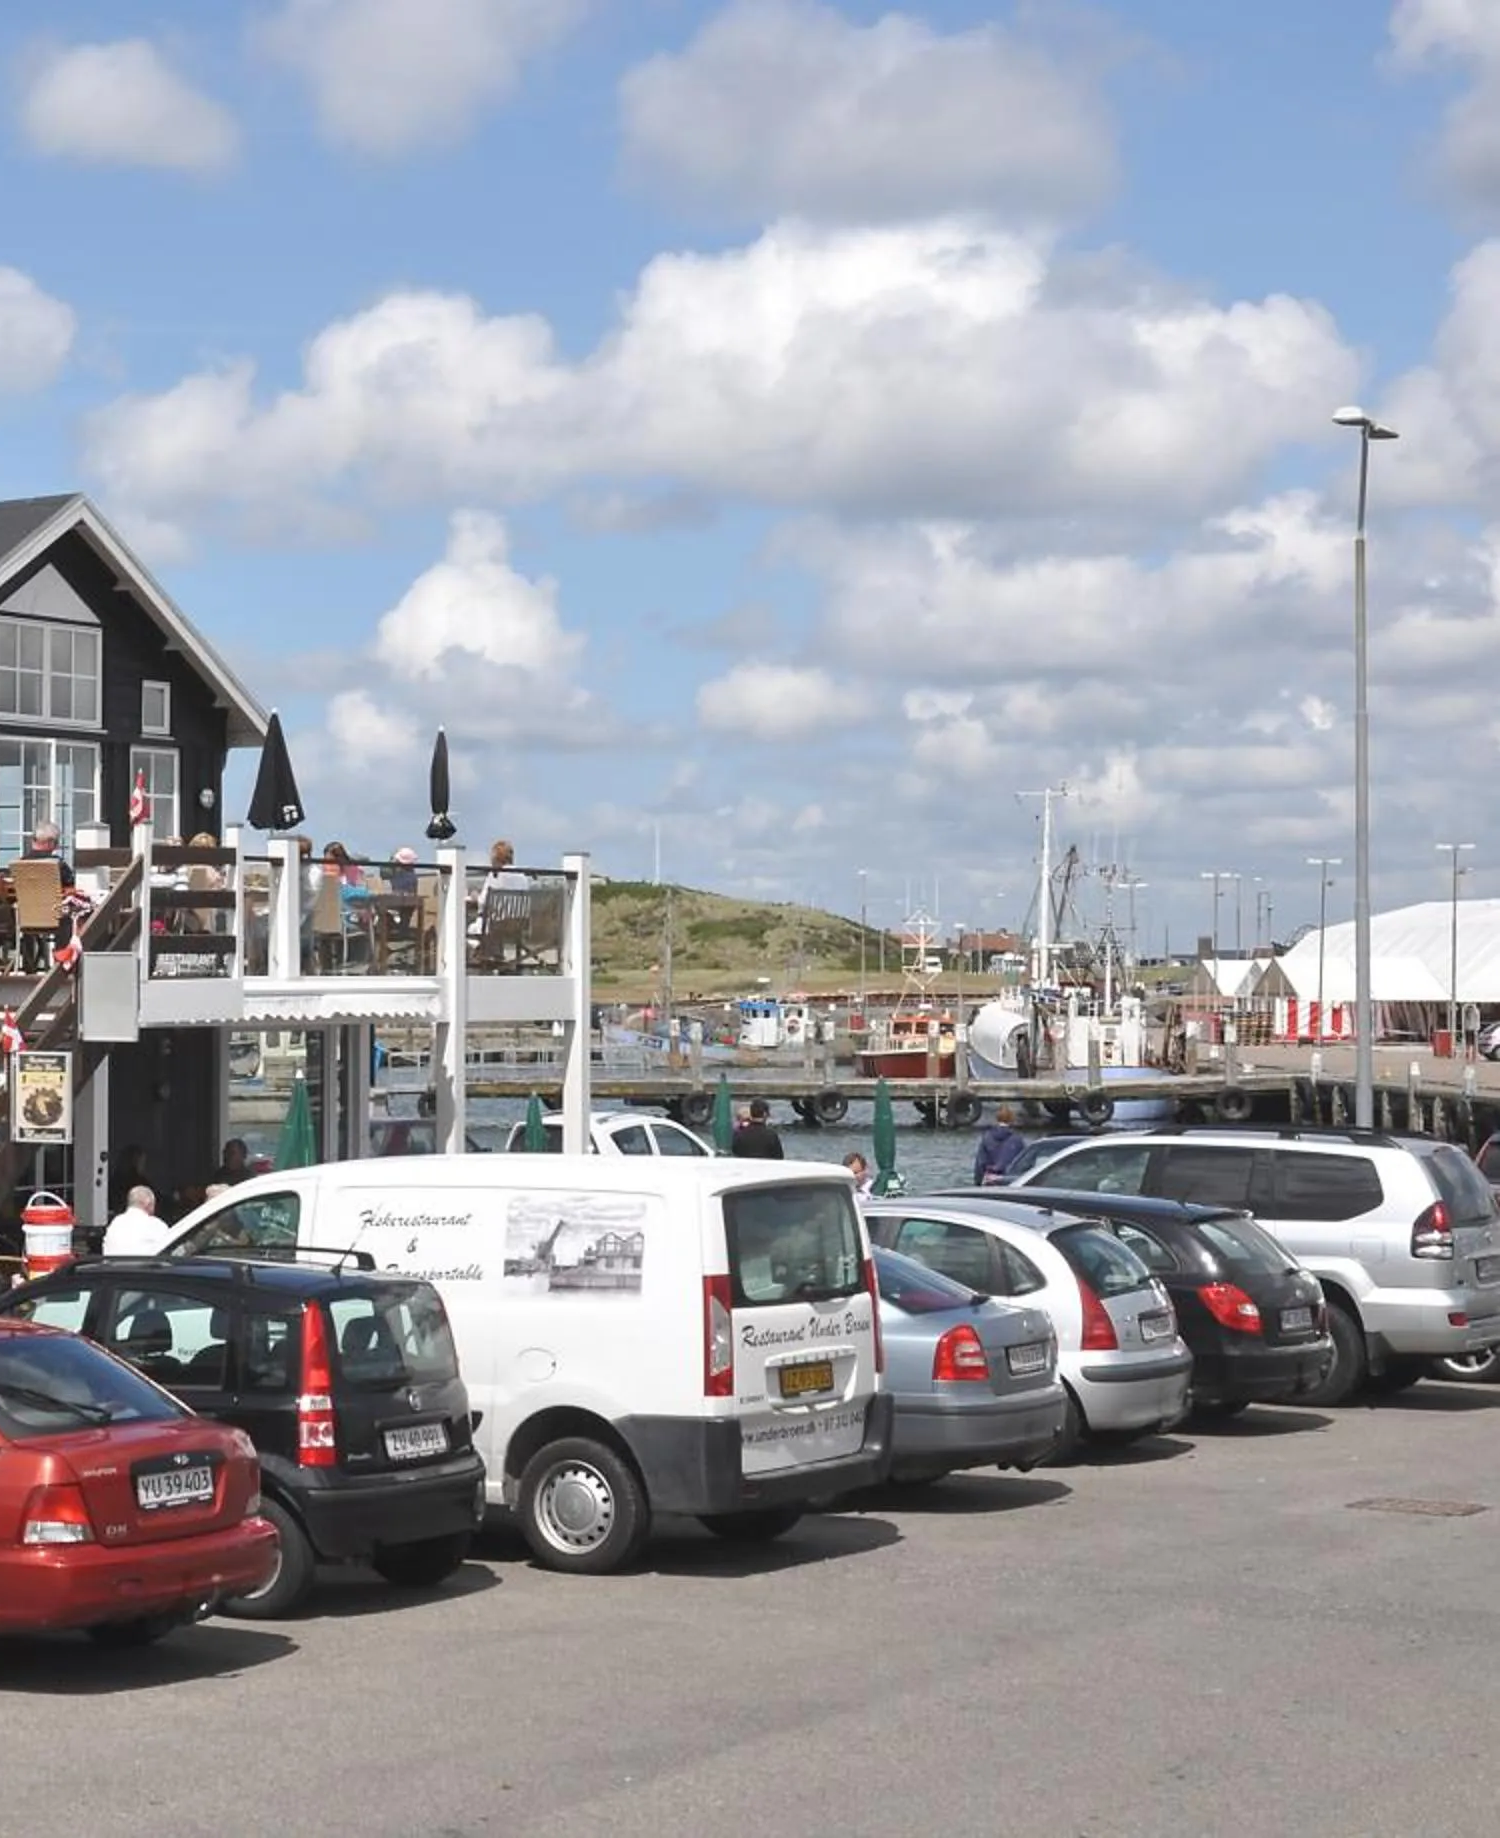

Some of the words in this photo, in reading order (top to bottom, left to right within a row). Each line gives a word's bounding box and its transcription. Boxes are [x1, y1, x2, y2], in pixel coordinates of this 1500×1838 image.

[740, 1324, 805, 1348] Restaurant
[141, 1478, 162, 1498] YU
[164, 1474, 182, 1496] 39
[184, 1469, 210, 1490] 403
